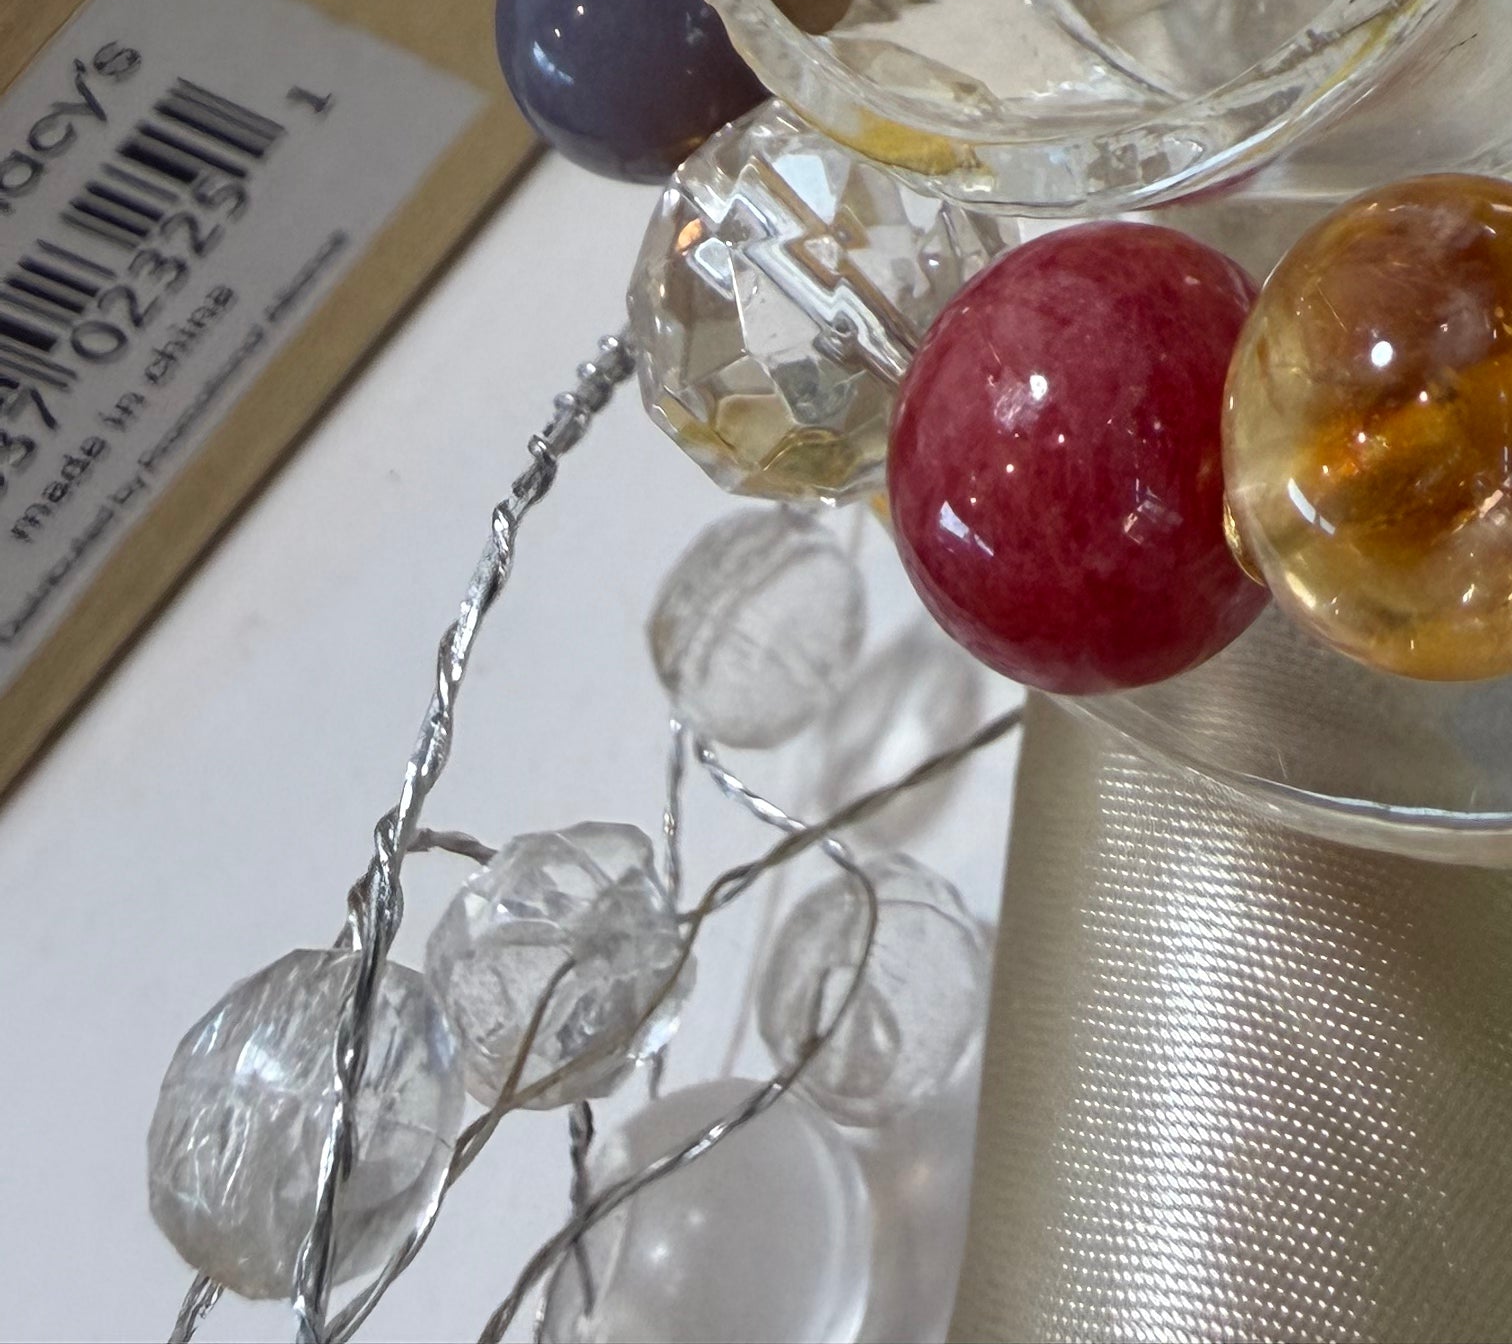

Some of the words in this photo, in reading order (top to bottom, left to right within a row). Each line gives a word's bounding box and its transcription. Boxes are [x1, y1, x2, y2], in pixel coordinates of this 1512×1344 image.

[0, 40, 142, 216] acy's
[71, 170, 248, 364] 02325
[286, 85, 334, 119] 1
[11, 435, 107, 543] made
[100, 391, 146, 433] in
[145, 284, 236, 384] china
